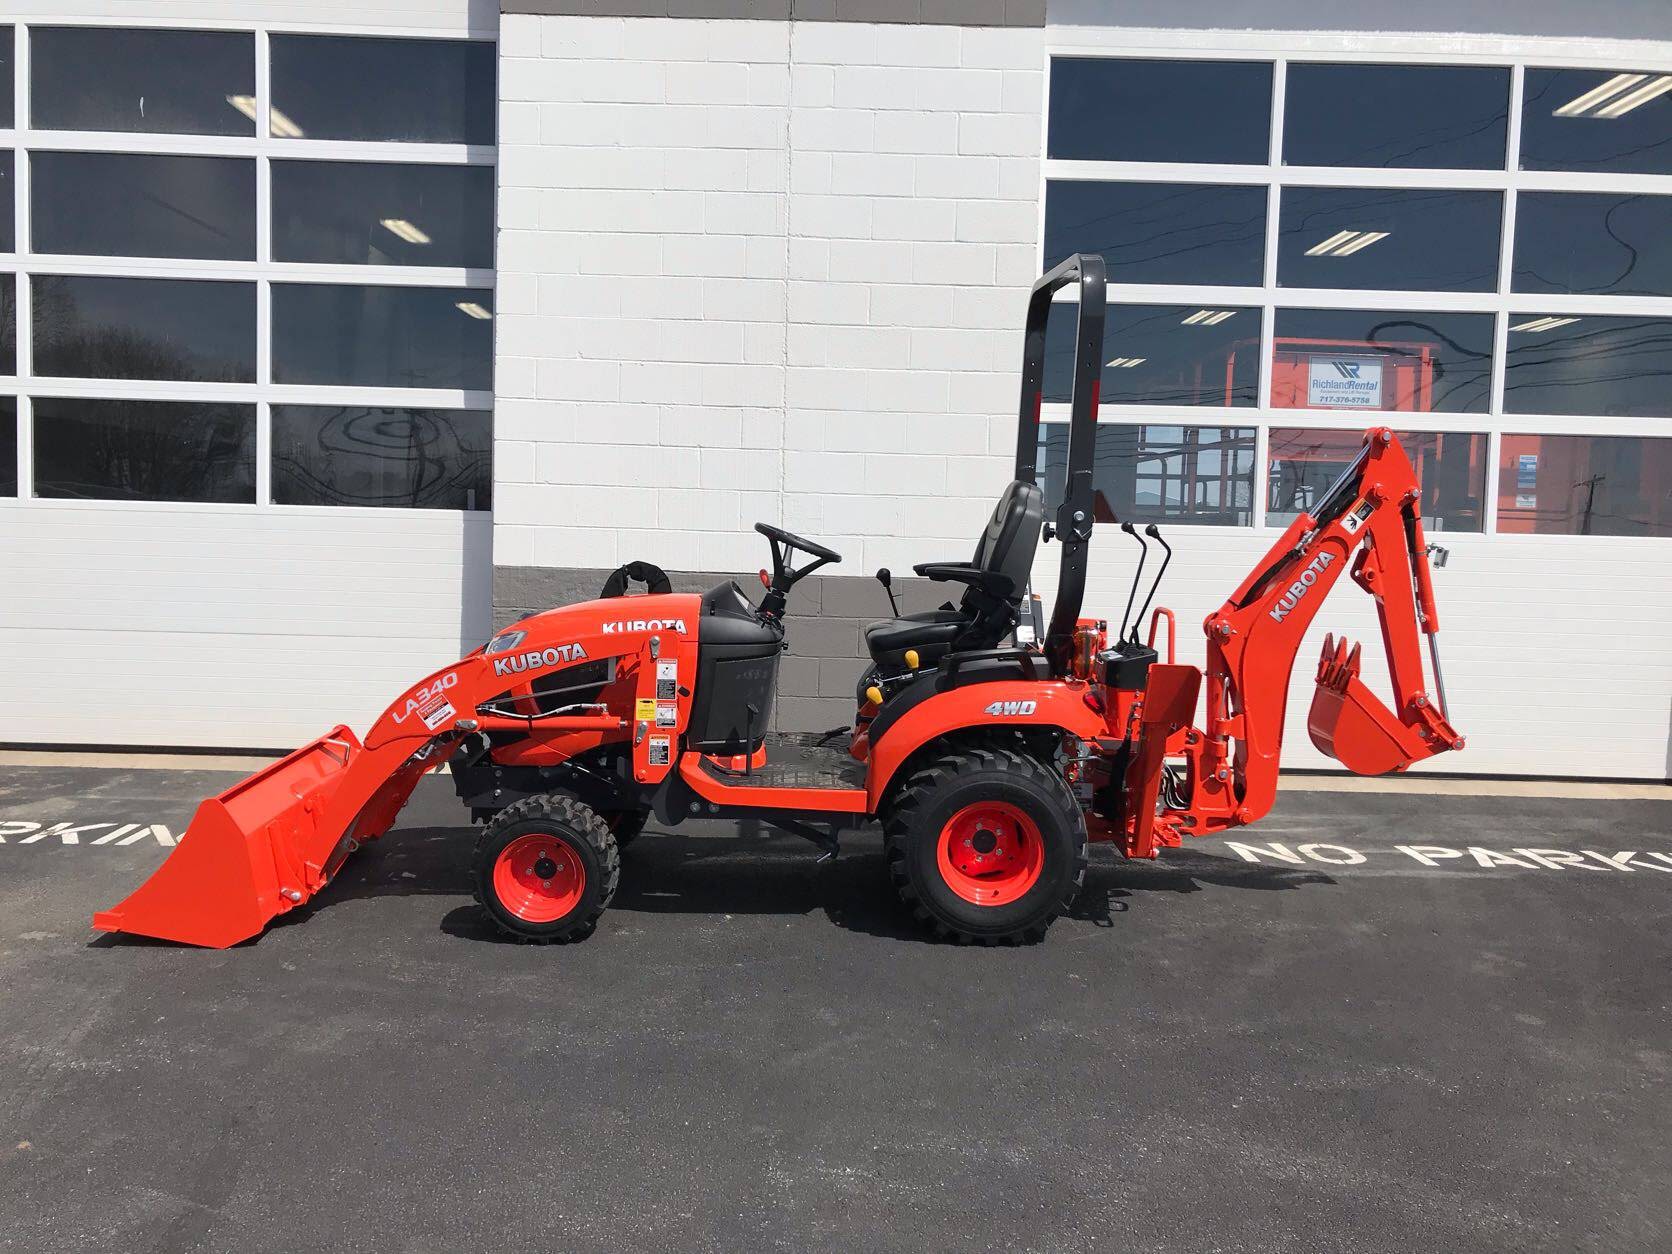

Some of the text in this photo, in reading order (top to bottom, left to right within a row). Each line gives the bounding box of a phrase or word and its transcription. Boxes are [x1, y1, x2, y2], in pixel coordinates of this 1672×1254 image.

[1269, 551, 1337, 623] KUBOTA
[602, 619, 688, 635] KUBOTA
[493, 642, 589, 676] KUBOTA
[392, 672, 458, 724] LA340
[984, 700, 1037, 716] 4WD
[1223, 841, 1367, 865] NO
